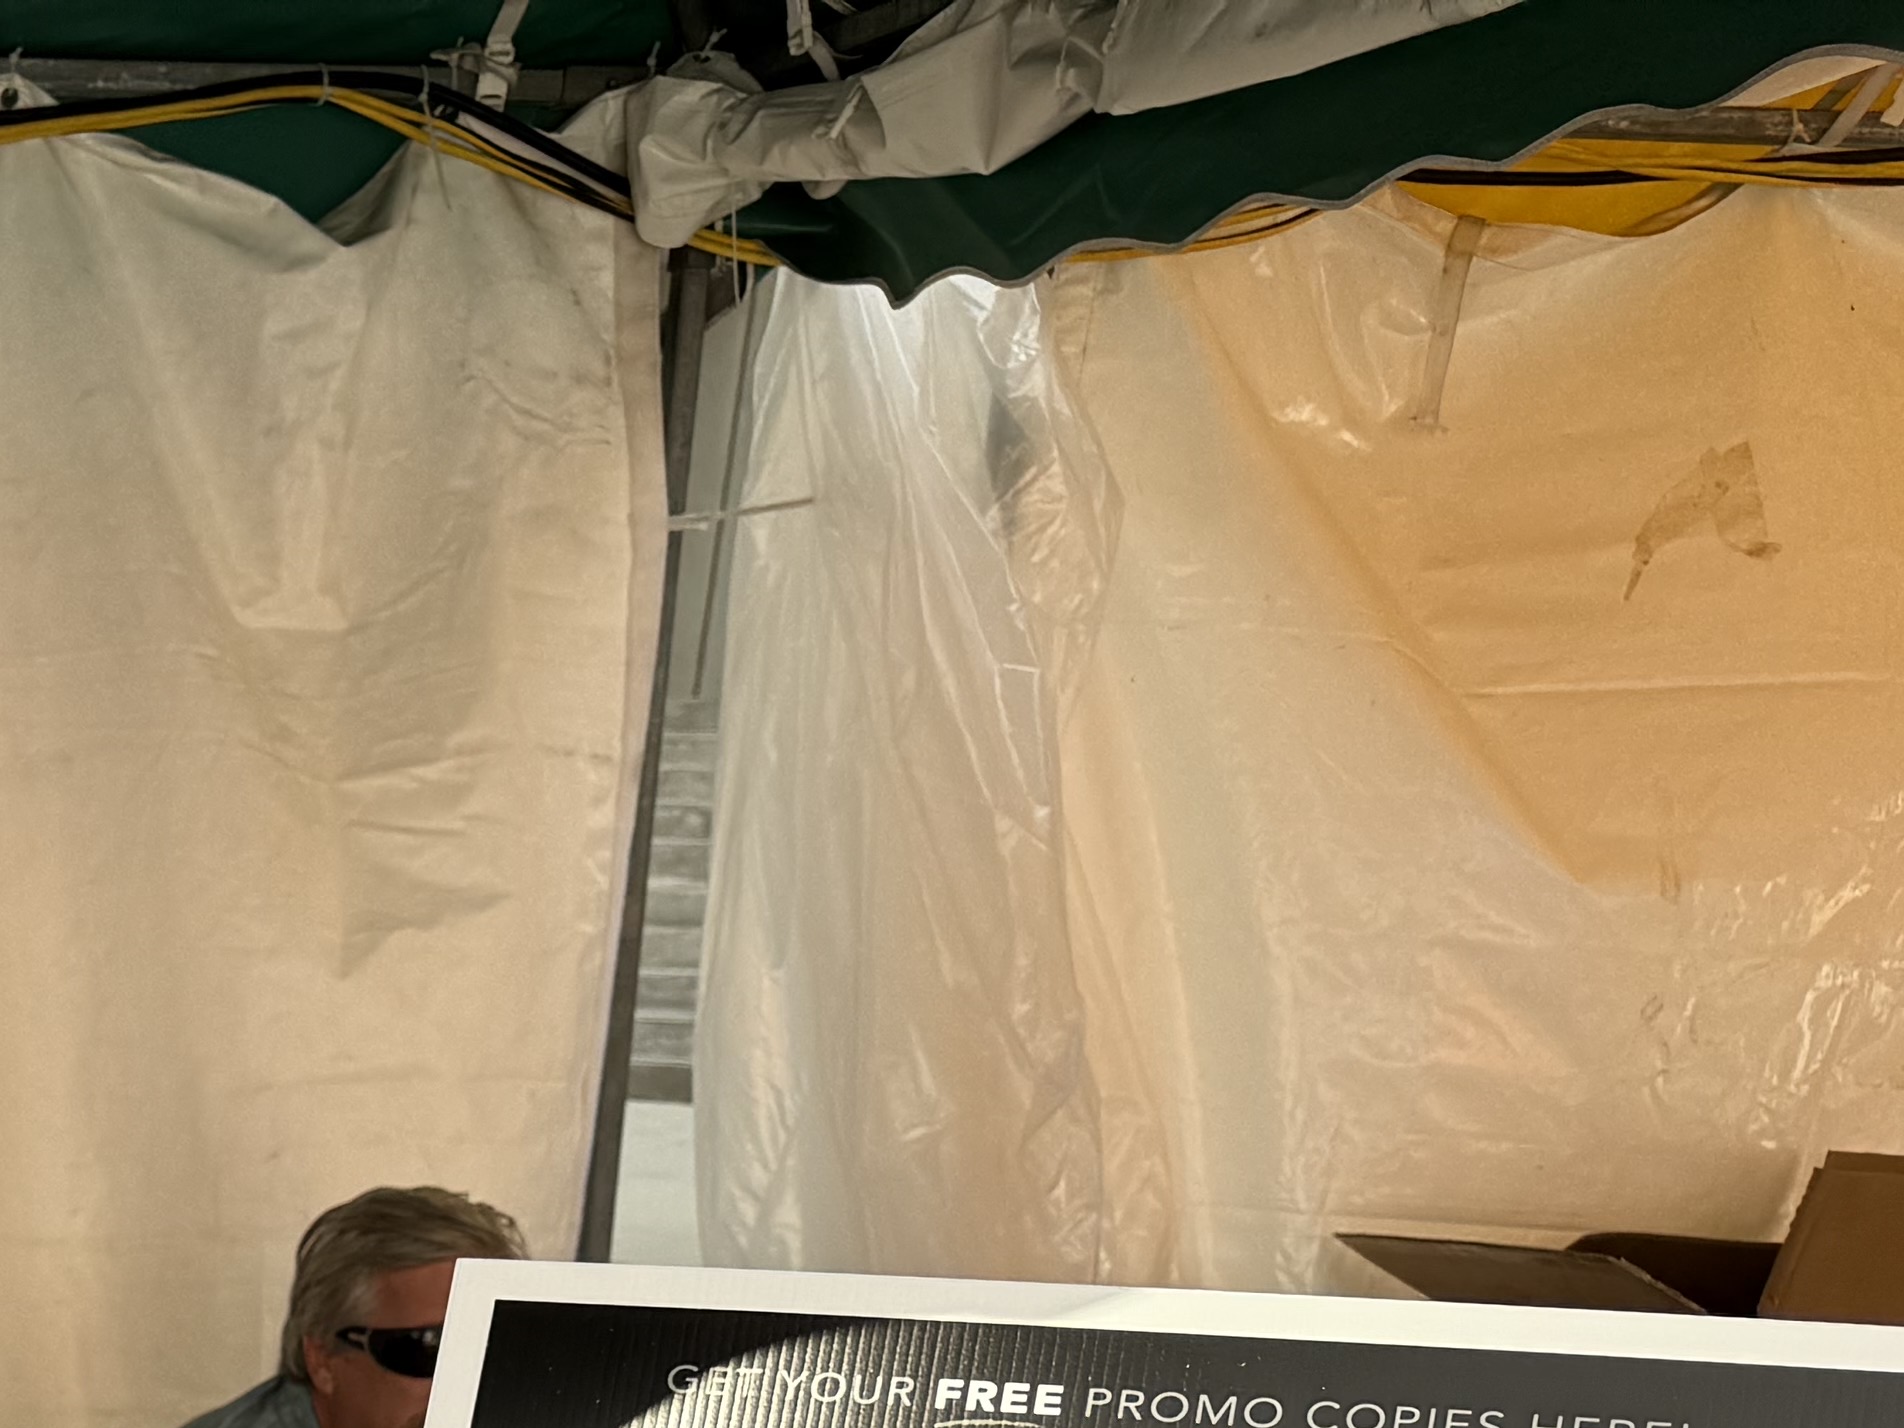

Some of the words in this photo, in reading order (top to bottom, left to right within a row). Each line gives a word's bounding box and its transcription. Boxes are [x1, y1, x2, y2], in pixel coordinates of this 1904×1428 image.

[667, 1365, 763, 1400] GET
[778, 1372, 914, 1406] YOUR
[934, 1378, 1065, 1416] FREE
[1084, 1388, 1283, 1428] PROMO
